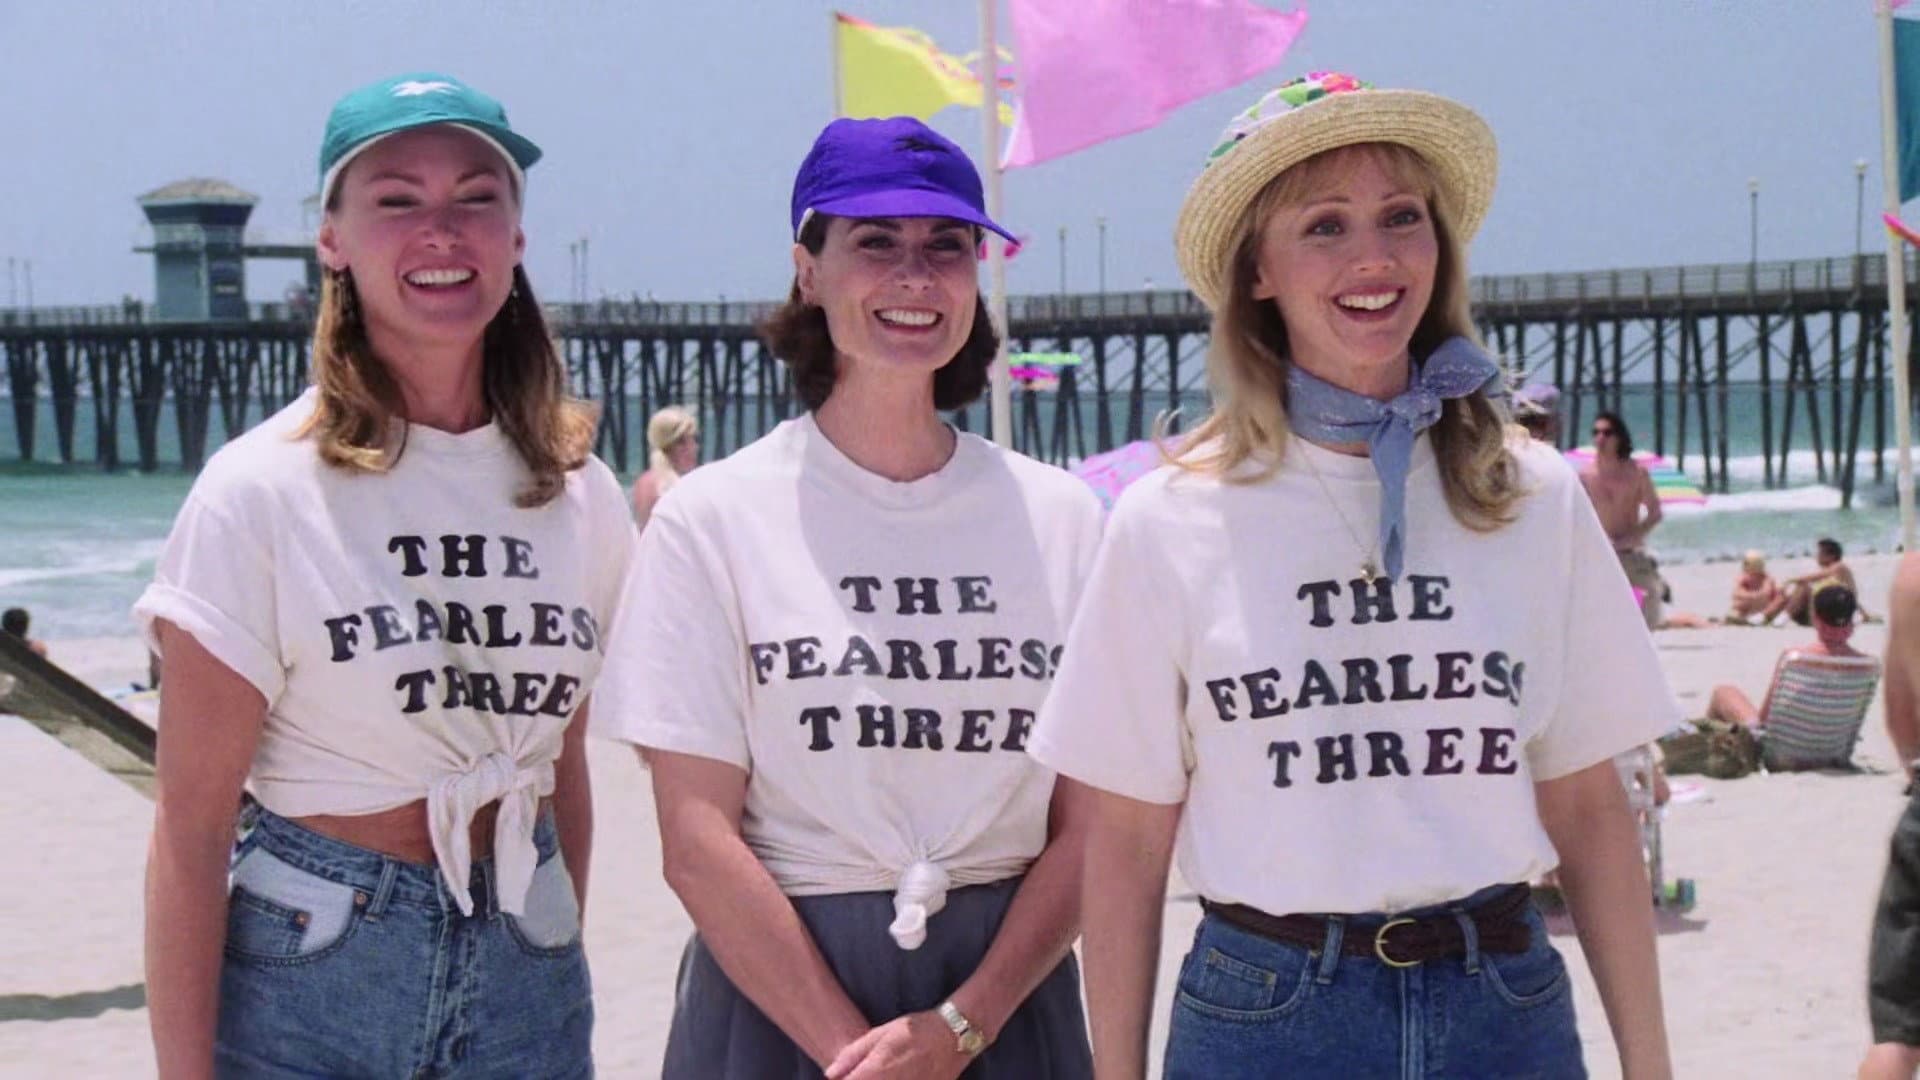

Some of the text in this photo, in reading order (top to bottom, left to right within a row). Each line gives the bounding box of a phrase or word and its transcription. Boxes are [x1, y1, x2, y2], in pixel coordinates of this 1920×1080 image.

[387, 534, 539, 580] THE
[839, 575, 997, 615] THE
[1297, 574, 1454, 628] THE
[324, 598, 604, 662] FEARLES
[395, 665, 581, 718] THREE
[1267, 727, 1518, 789] THREE
